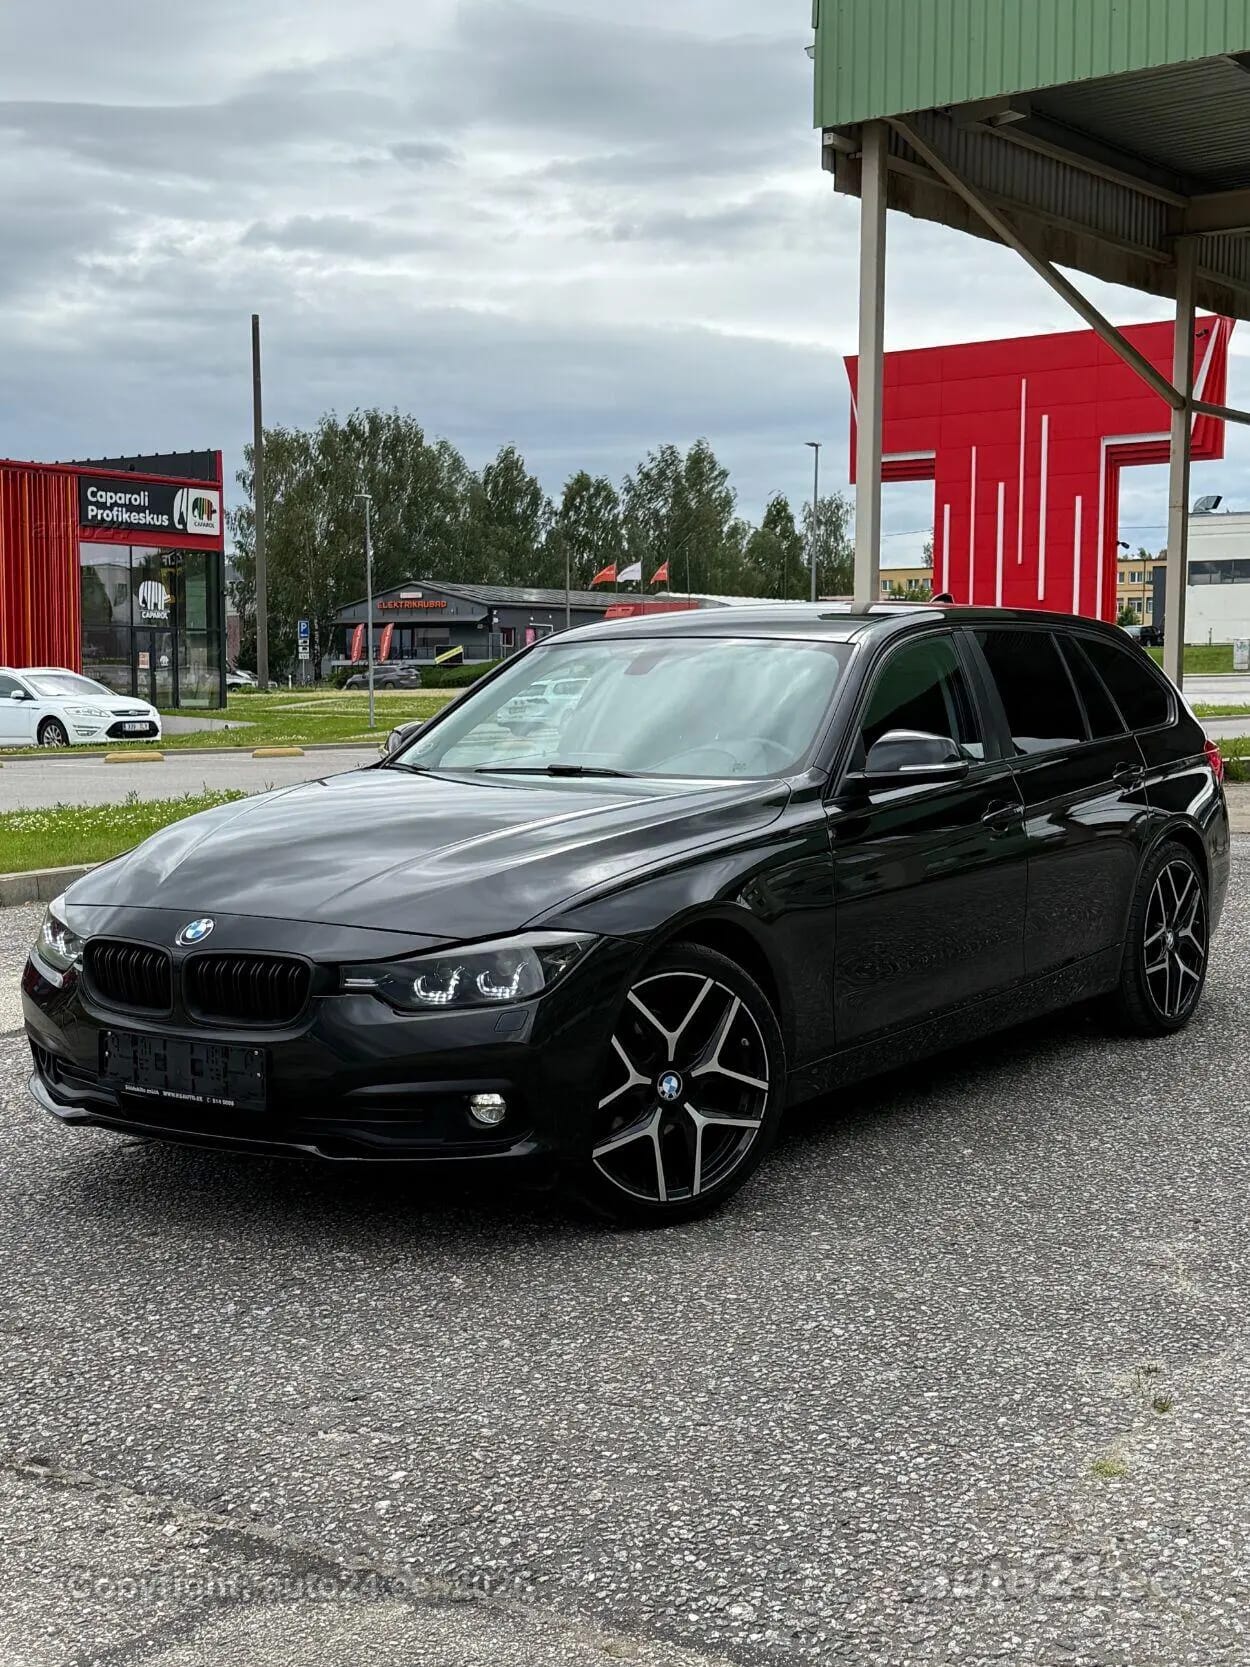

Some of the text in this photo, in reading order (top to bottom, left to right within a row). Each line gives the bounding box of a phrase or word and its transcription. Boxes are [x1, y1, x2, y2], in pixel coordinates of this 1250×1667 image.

[87, 487, 148, 506] Caparoli
[87, 506, 169, 526] Profikeskus
[194, 521, 215, 529] CAPAROL
[377, 600, 447, 609] ELEKTRIKAUBAD
[141, 611, 168, 619] CAPAROL
[300, 622, 307, 633] P
